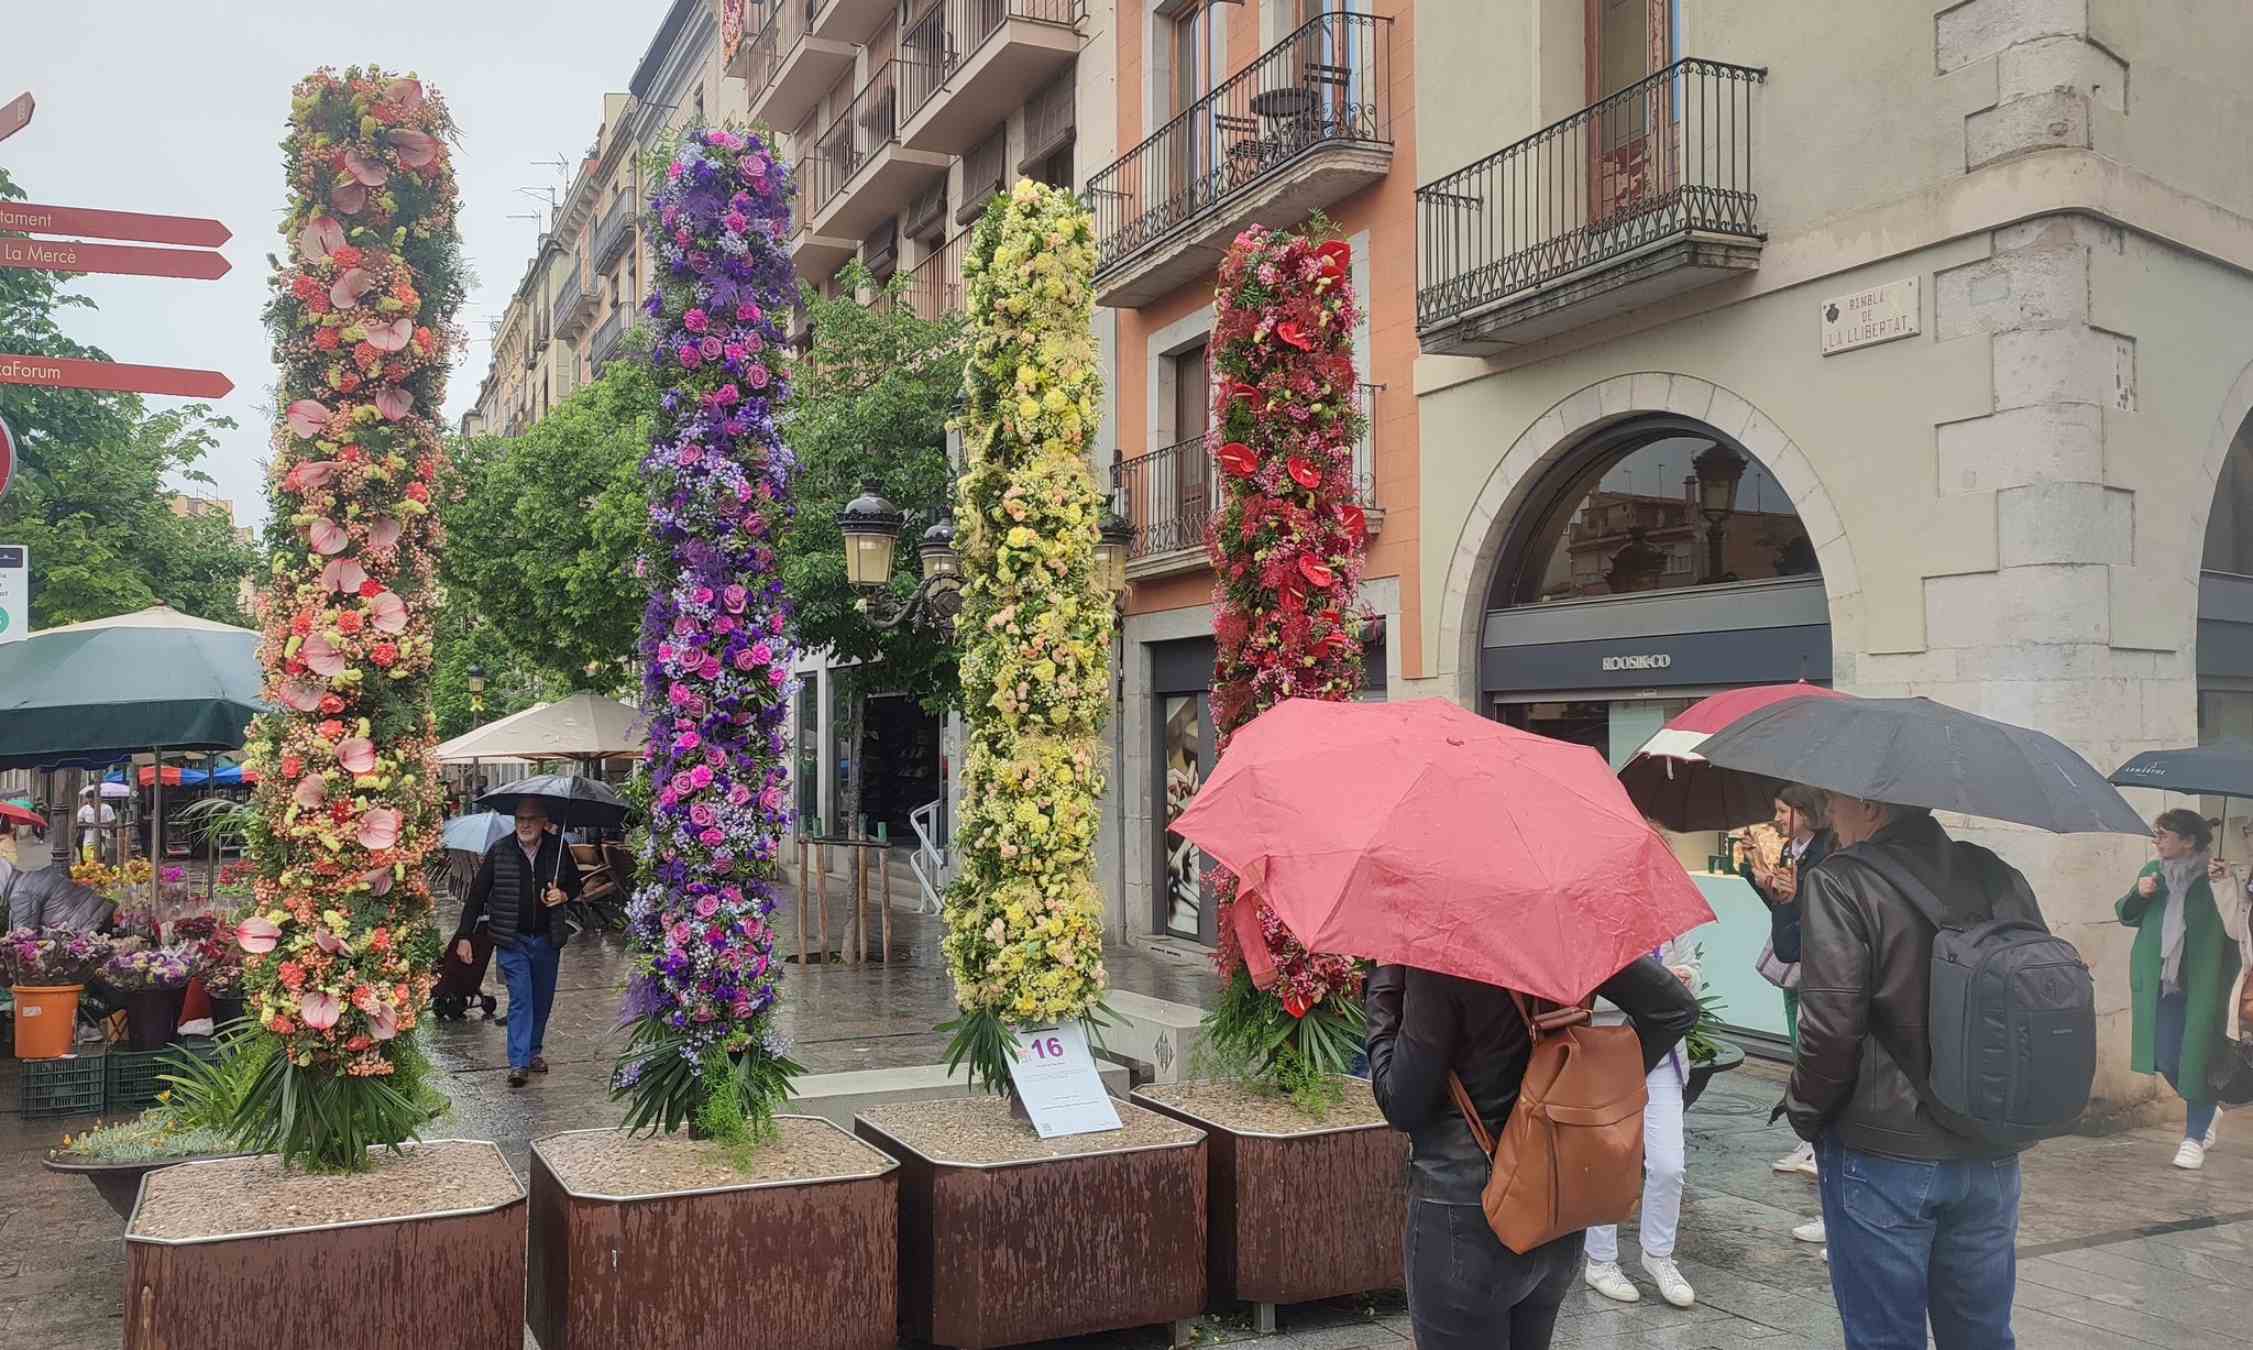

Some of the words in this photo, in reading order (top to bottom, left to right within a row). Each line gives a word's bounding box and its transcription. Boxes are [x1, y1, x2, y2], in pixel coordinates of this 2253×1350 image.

[5, 243, 22, 261] La
[27, 245, 77, 265] Mercè
[1862, 308, 1873, 322] DE
[1847, 315, 1907, 343] LLIBERTAT
[1031, 1036, 1064, 1059] 16
